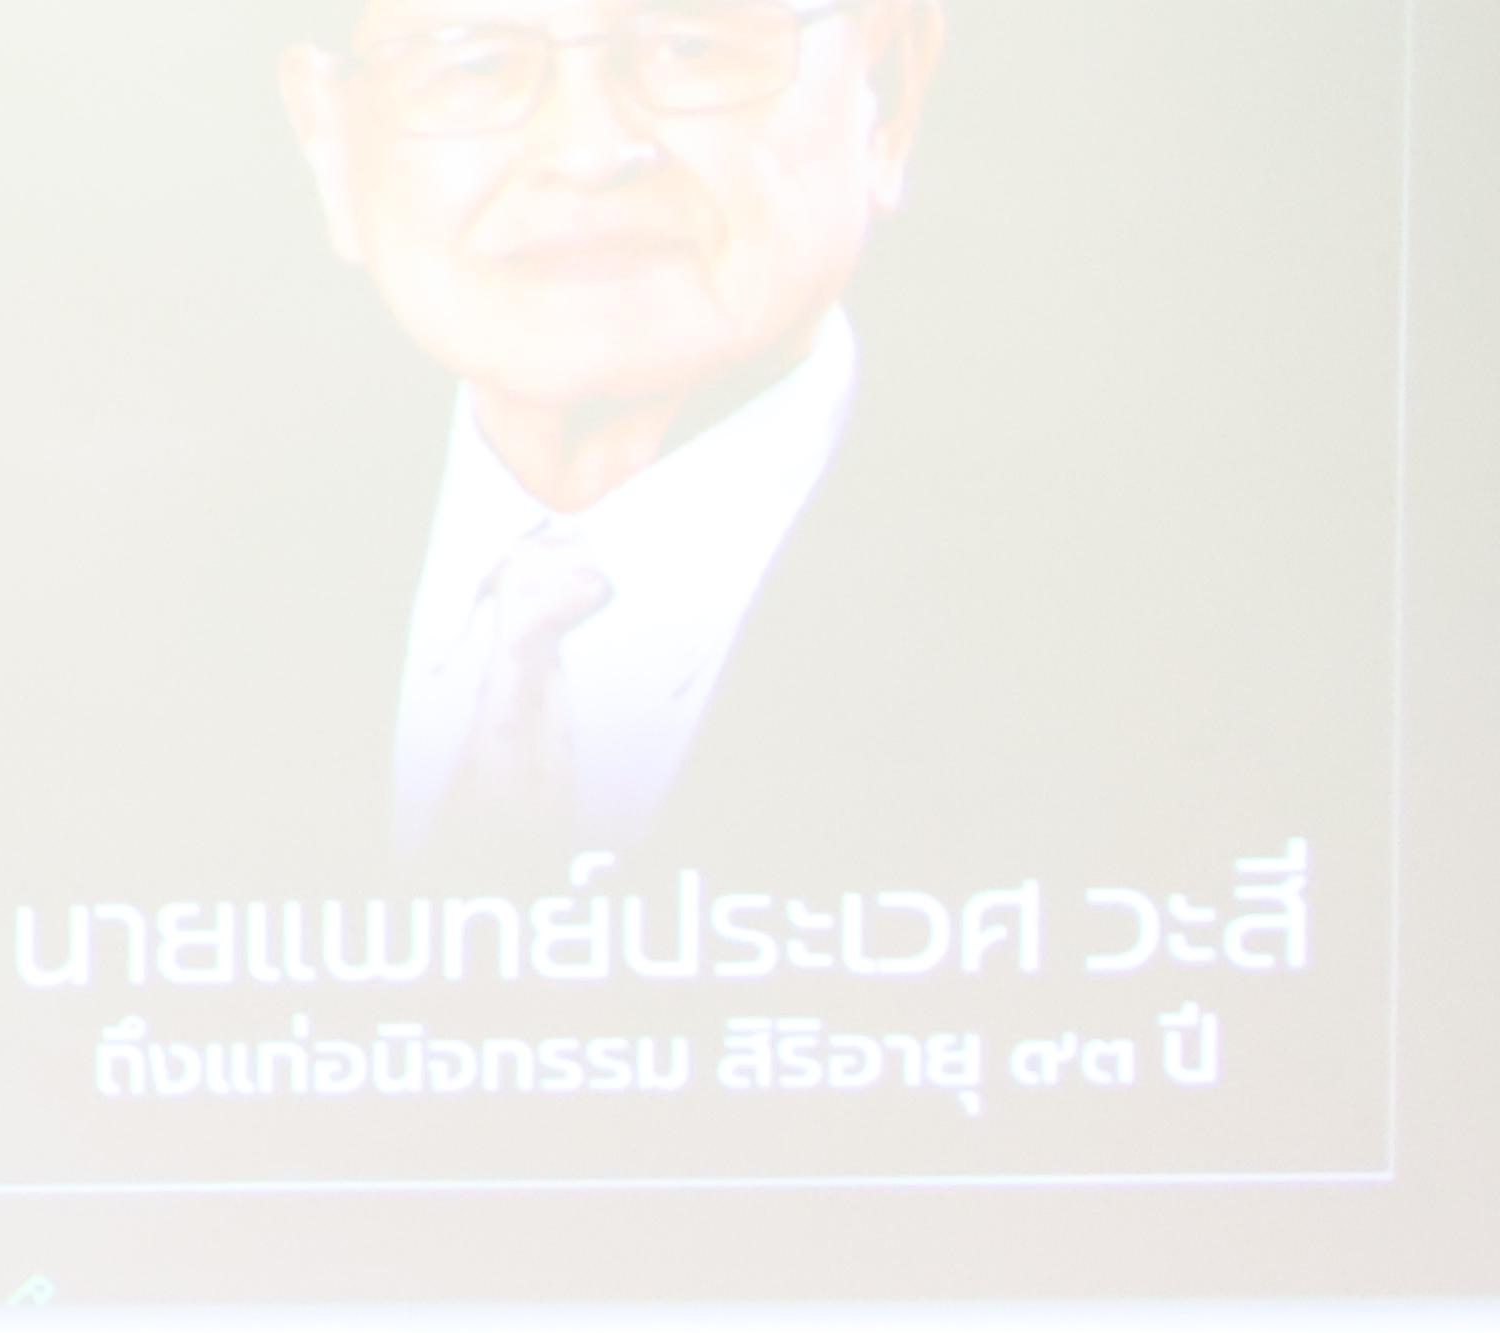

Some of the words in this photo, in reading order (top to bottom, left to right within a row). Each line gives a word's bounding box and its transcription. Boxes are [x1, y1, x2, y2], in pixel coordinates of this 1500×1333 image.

[14, 851, 1041, 989] นายแพทย์ประเวศ
[1084, 837, 1309, 975] วะสี
[96, 1013, 690, 1097] ถึงแก่อนิจกรรม
[717, 1016, 983, 1117] สิริอายุ
[1010, 1030, 1136, 1087] ๙๓
[1157, 1001, 1220, 1085] ปี
